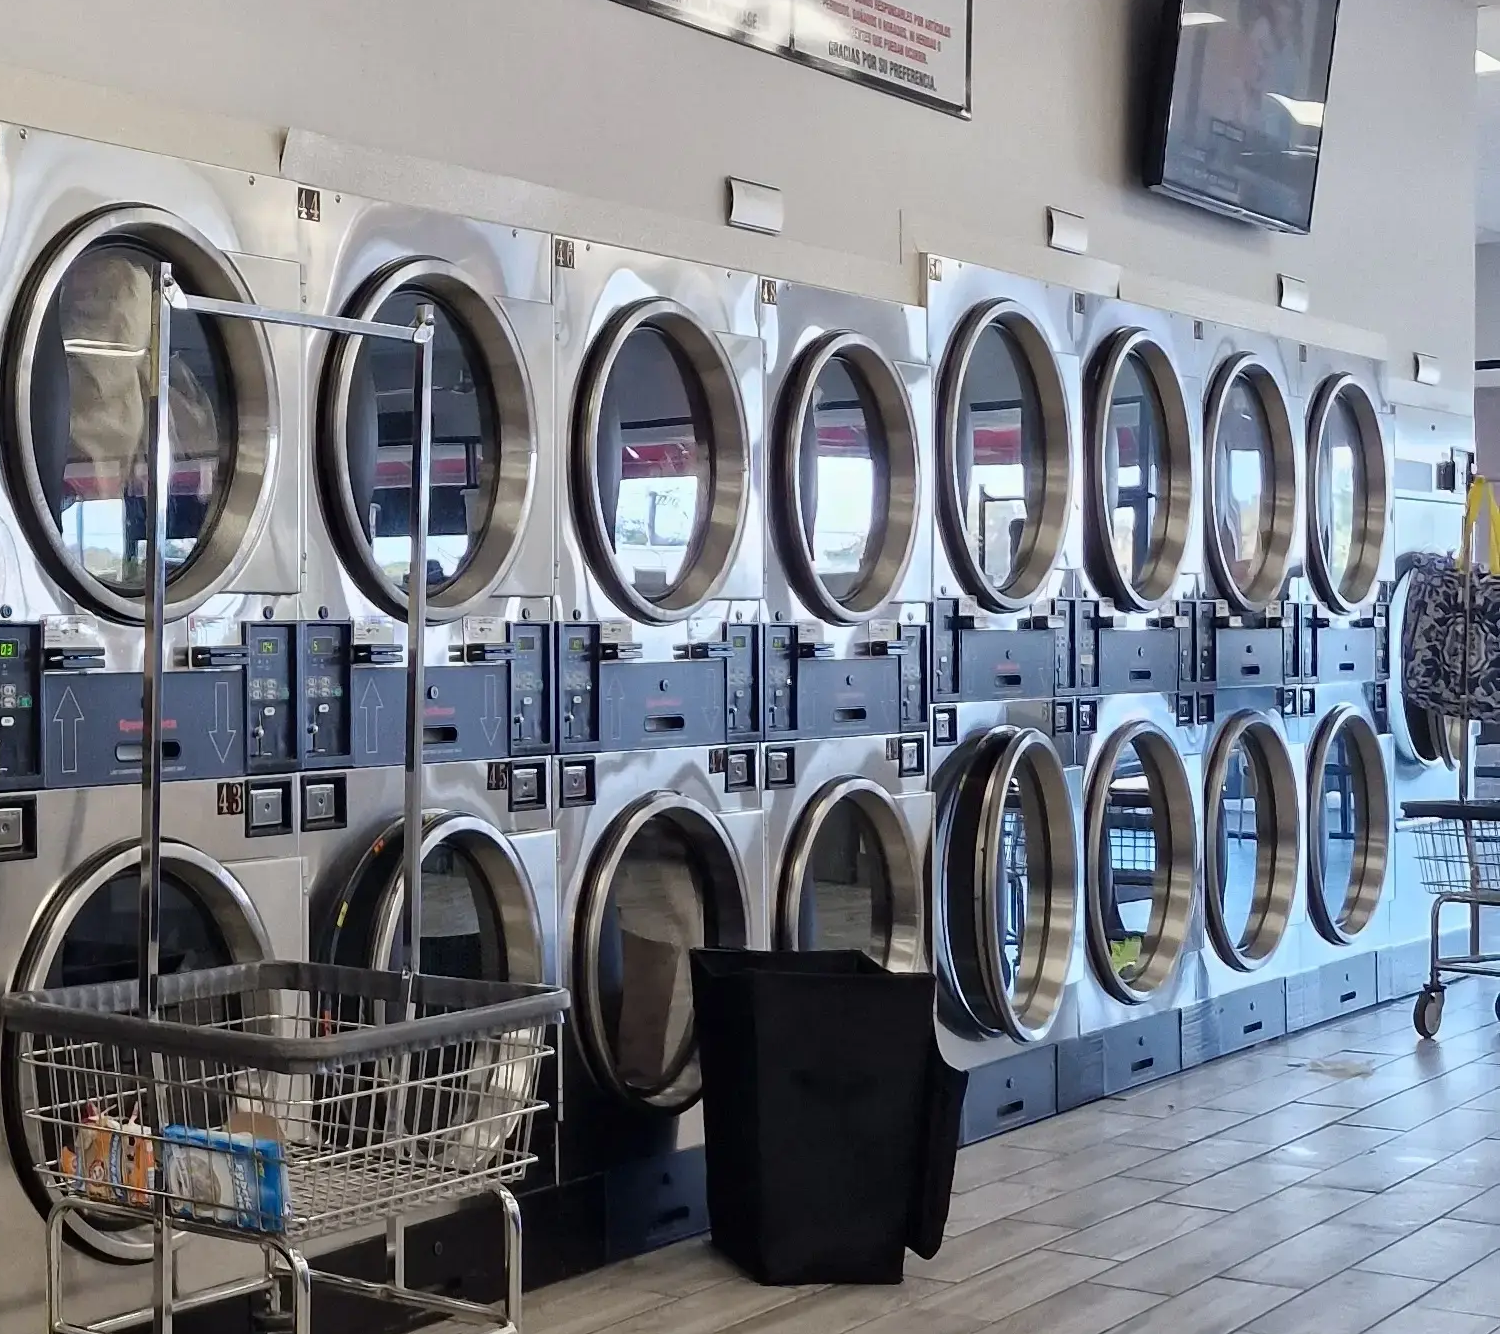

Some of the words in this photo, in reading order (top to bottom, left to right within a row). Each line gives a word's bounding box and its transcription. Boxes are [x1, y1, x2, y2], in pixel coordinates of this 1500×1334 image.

[828, 41, 860, 65] GRACIAS
[862, 50, 876, 70] POR
[878, 57, 888, 74] SU
[298, 189, 320, 221] 44
[556, 240, 574, 268] 46
[487, 763, 508, 790] 45
[219, 784, 243, 815] 43
